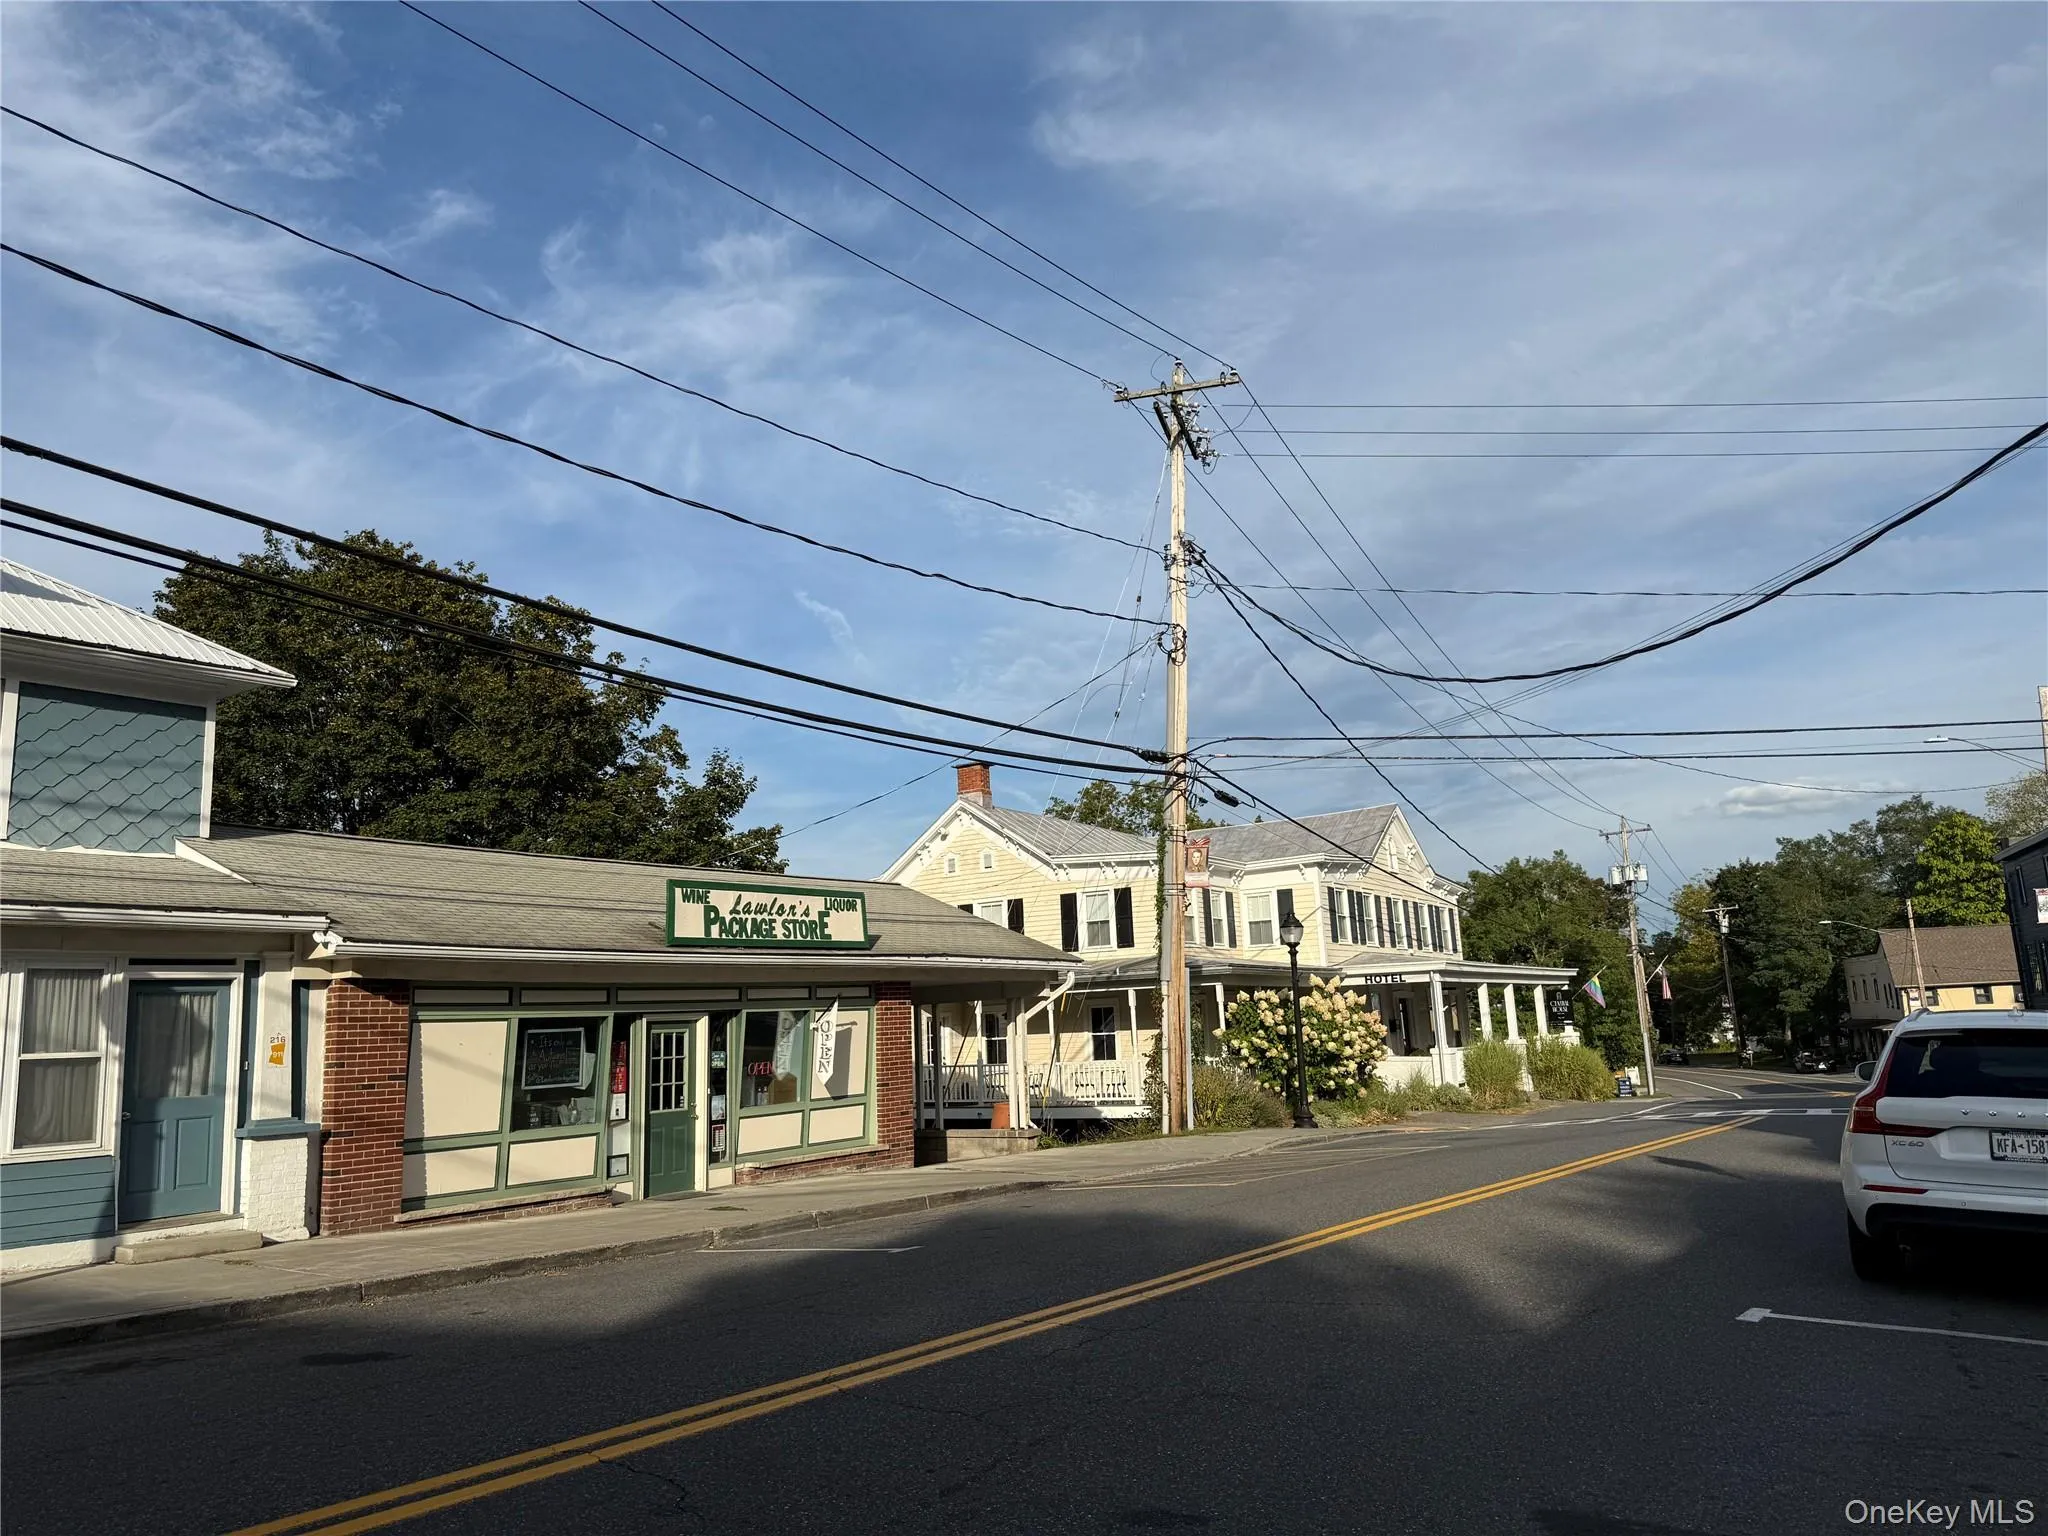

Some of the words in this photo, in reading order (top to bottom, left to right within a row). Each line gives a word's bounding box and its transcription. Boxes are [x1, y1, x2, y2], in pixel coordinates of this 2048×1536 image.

[681, 888, 711, 904] WINE
[729, 894, 810, 918] Lawlor's
[824, 898, 858, 912] LIQUOR
[704, 905, 778, 939] PACKAGE
[782, 911, 832, 940] STORE
[1364, 974, 1406, 984] HOTEL
[818, 1020, 833, 1073] OPEN
[747, 1061, 774, 1076] OPEN
